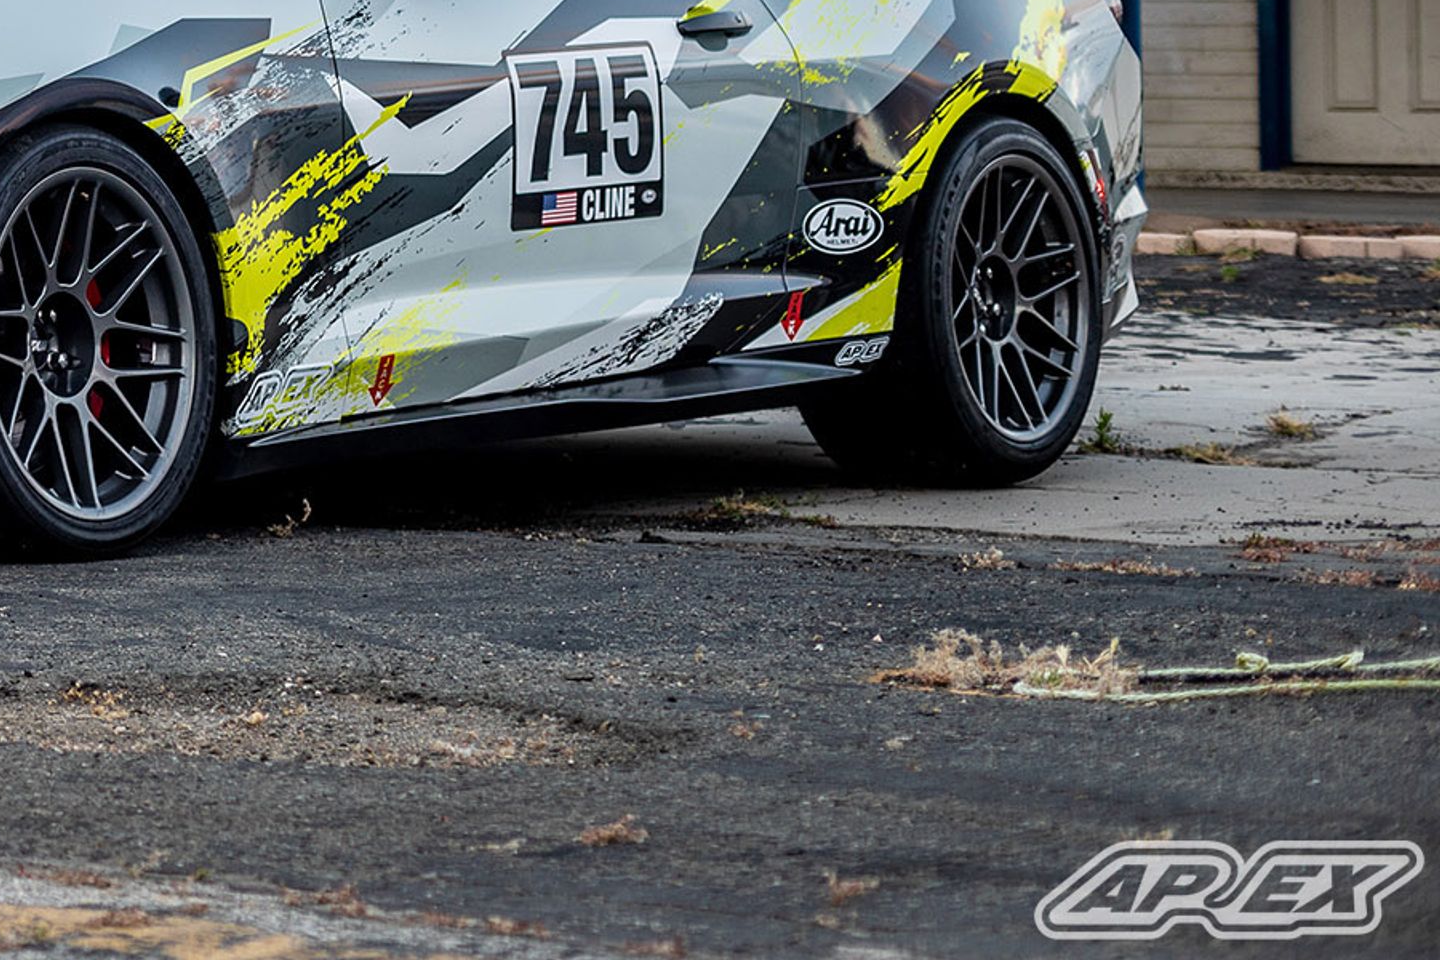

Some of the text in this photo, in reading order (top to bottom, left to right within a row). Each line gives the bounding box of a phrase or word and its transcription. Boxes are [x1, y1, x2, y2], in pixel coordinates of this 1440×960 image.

[514, 53, 655, 183] 745
[581, 185, 636, 222] CLINE
[810, 207, 872, 237] Arai
[373, 356, 393, 401] JACK
